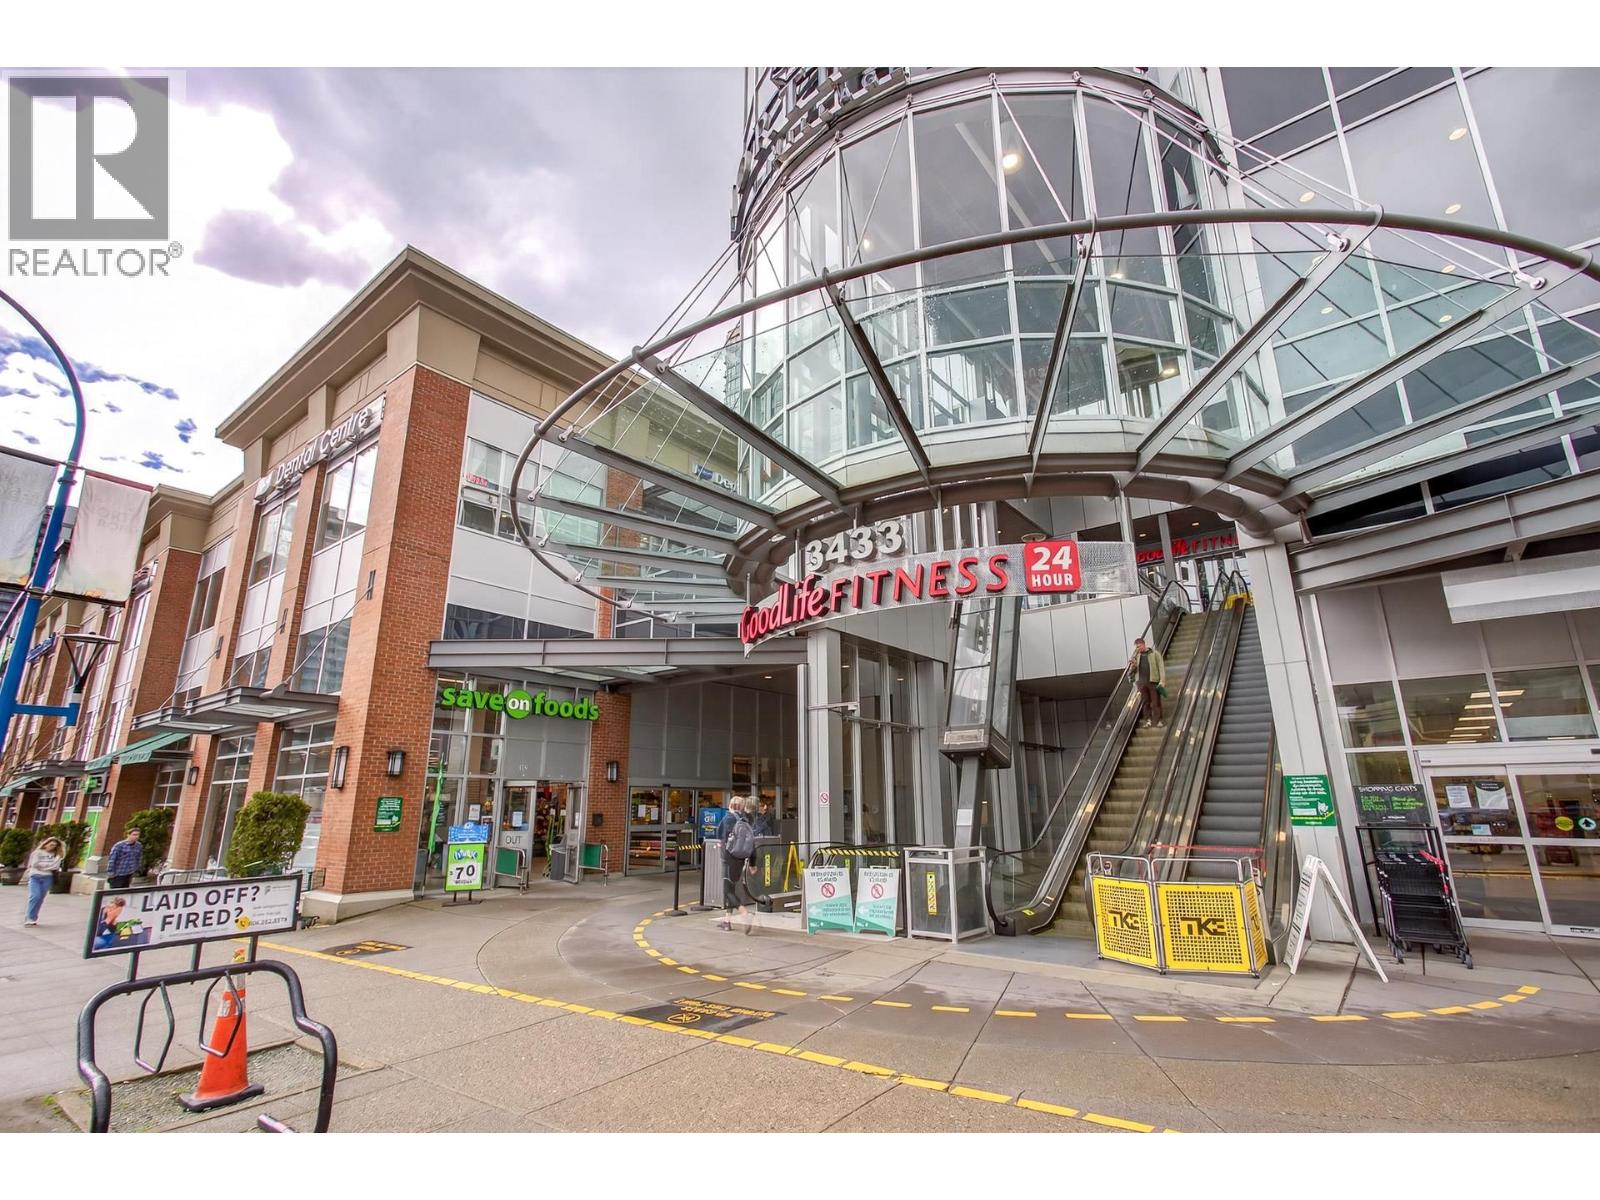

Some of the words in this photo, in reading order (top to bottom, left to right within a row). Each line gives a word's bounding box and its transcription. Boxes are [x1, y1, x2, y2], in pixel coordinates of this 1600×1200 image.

[277, 442, 317, 482] Dental
[320, 409, 368, 451] Centre
[805, 521, 902, 571] 3433
[1032, 545, 1073, 571] 24
[1031, 572, 1074, 588] HOUR
[740, 573, 830, 645] GoodLife
[829, 553, 1009, 613] FITNESS
[441, 687, 504, 712] save
[508, 697, 530, 712] on
[534, 691, 600, 721] foods
[505, 835, 523, 845] OUT
[141, 890, 198, 913] LAID
[204, 885, 261, 906] OFF?
[160, 907, 244, 932] FIRED?
[1107, 909, 1141, 931] TKE
[1180, 916, 1227, 936] TKE
